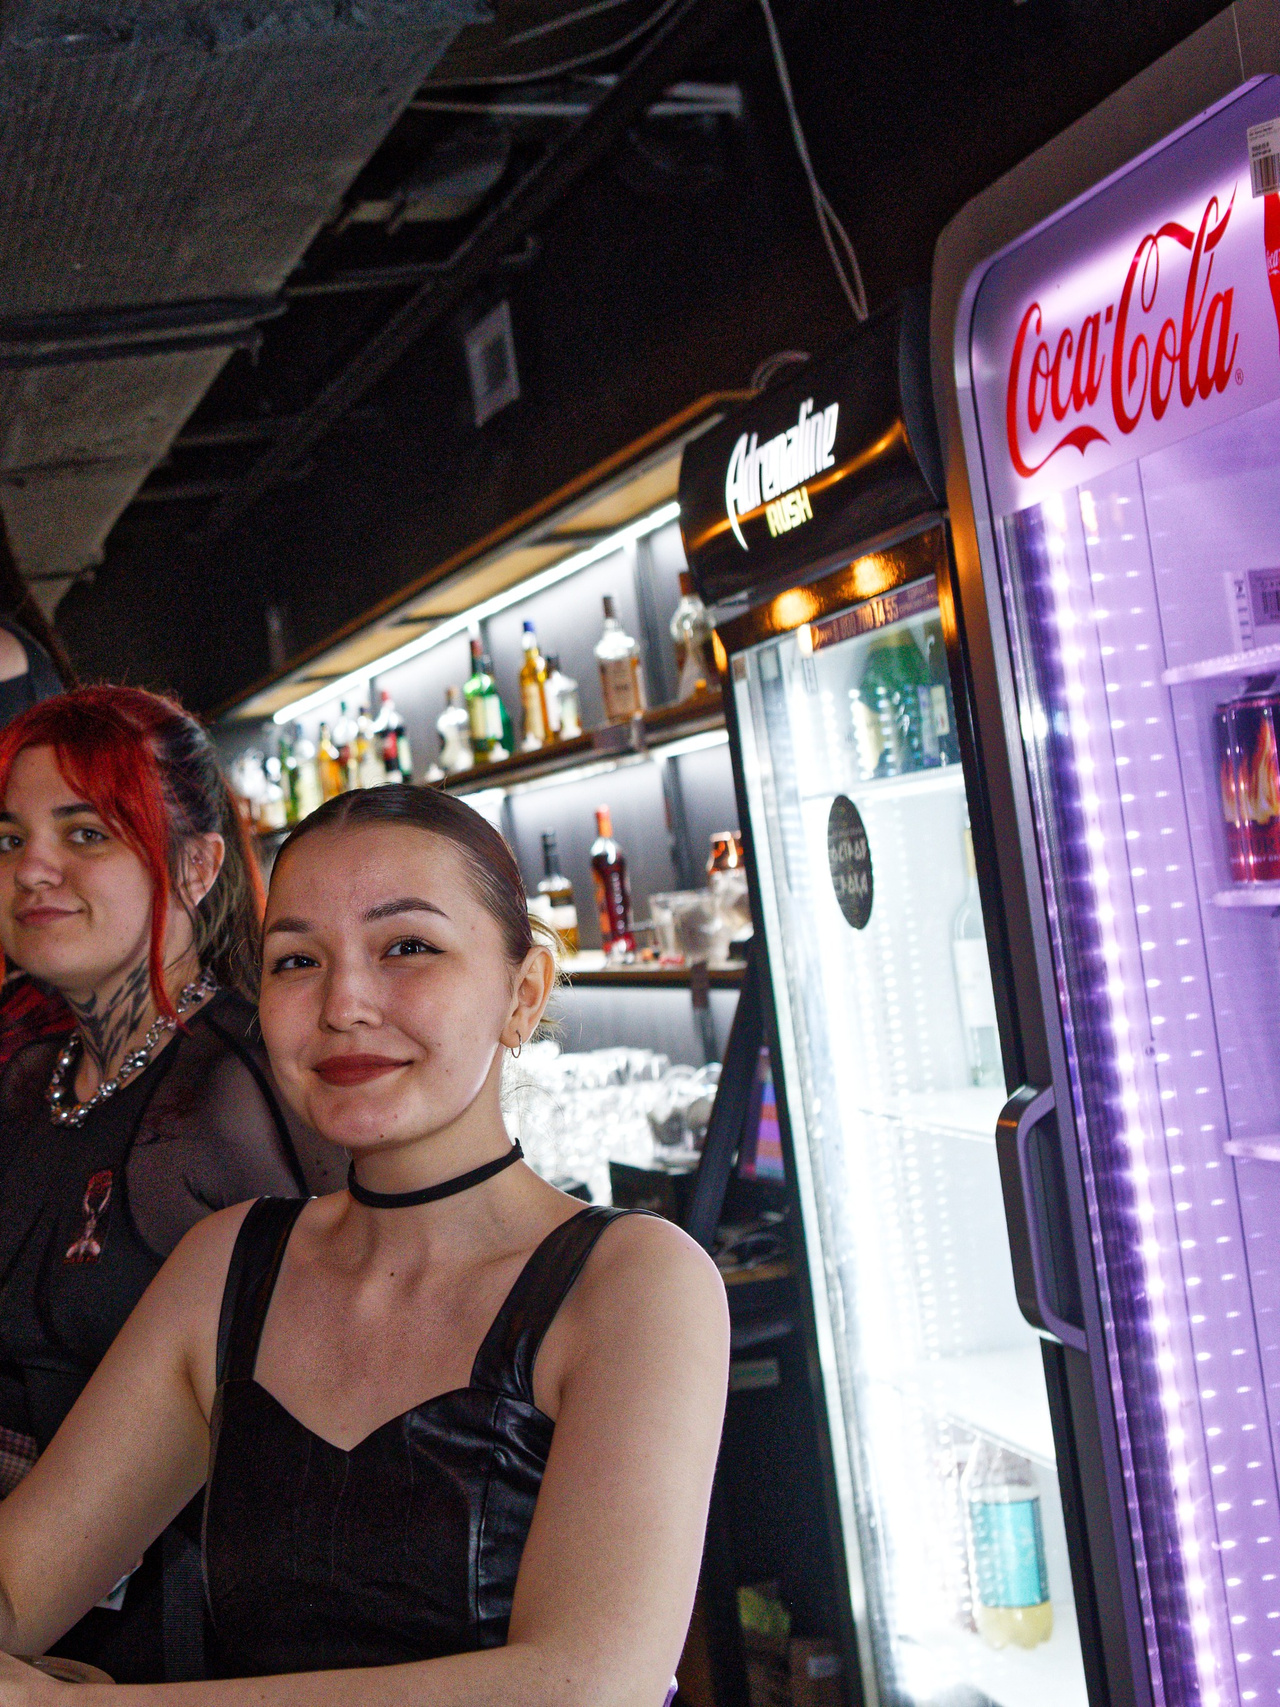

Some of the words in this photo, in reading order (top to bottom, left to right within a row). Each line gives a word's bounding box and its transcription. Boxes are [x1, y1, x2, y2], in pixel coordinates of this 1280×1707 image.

[1006, 181, 1240, 479] Coca-Cola
[725, 397, 839, 552] Adrenaline
[765, 486, 814, 538] RUSH
